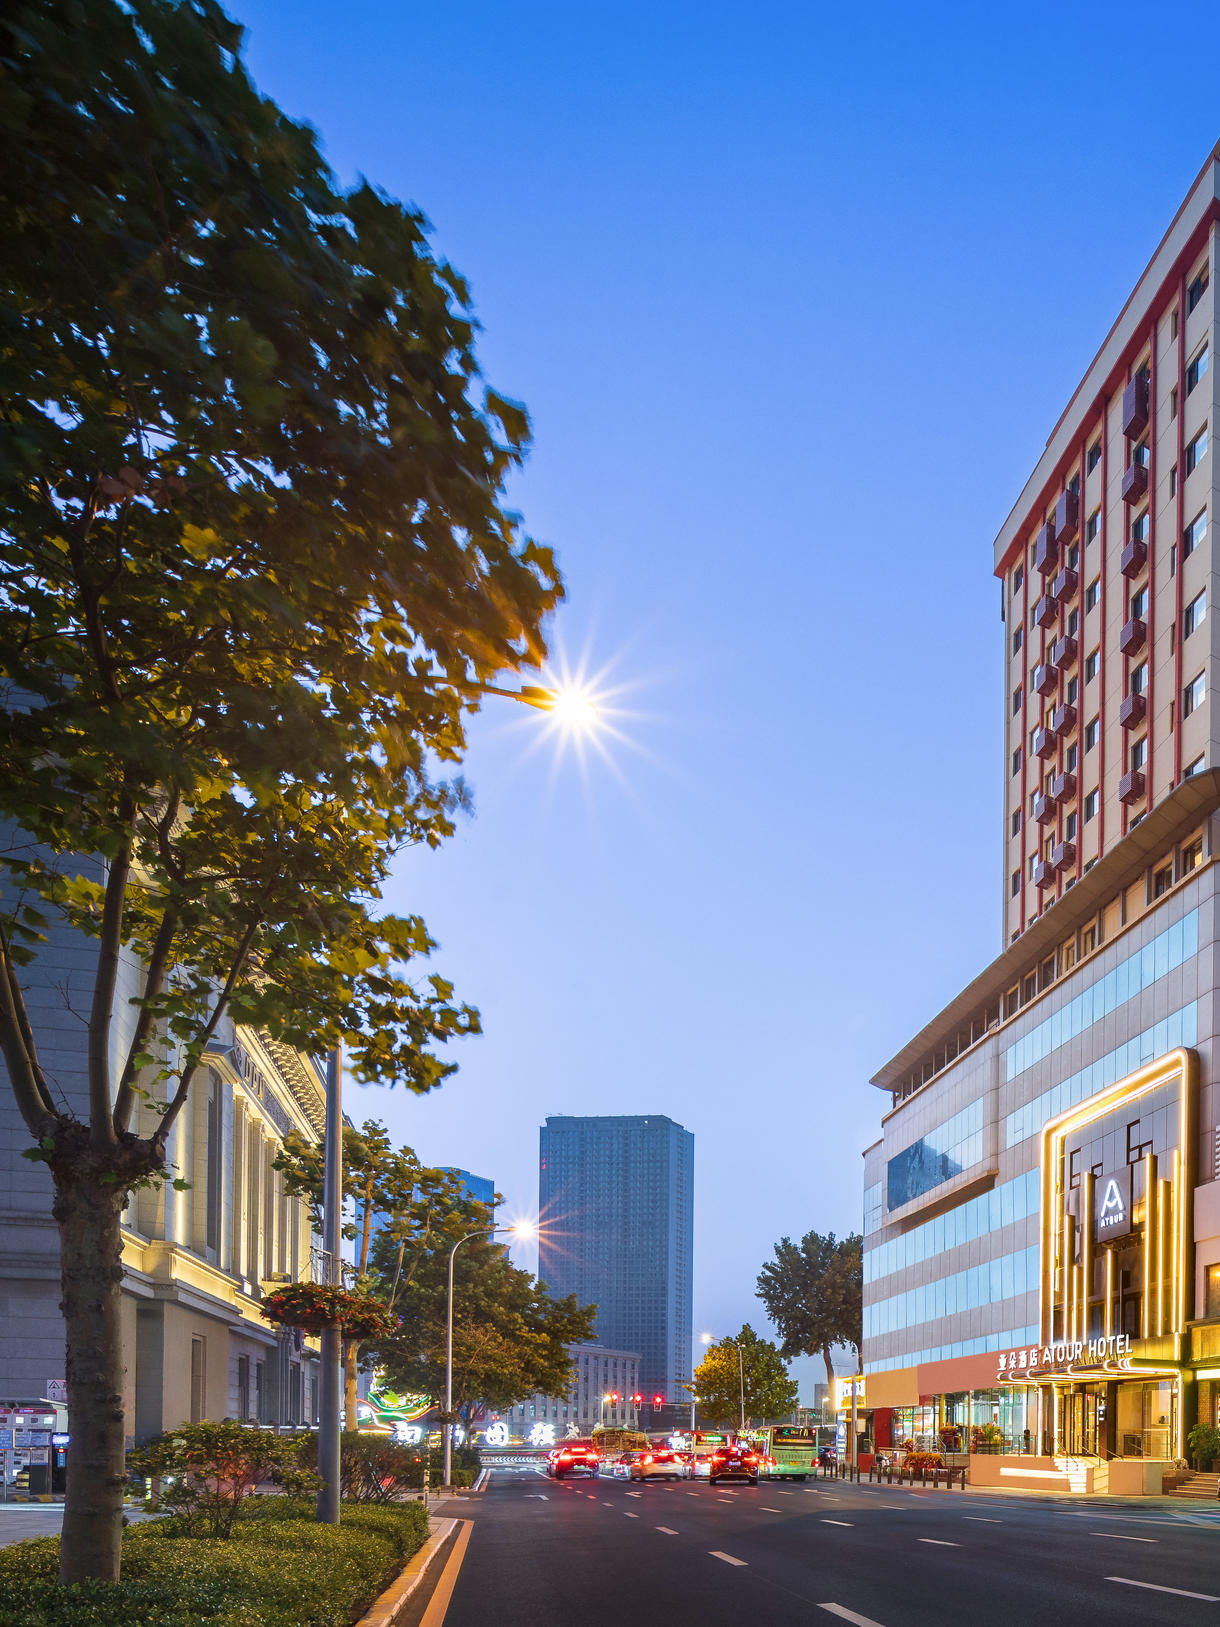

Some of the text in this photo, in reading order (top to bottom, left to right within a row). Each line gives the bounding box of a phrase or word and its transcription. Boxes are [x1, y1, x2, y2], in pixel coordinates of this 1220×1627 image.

[1100, 1213, 1124, 1228] ATOUR
[1043, 1342, 1083, 1364] ATOUR
[1088, 1334, 1133, 1357] HOTEL
